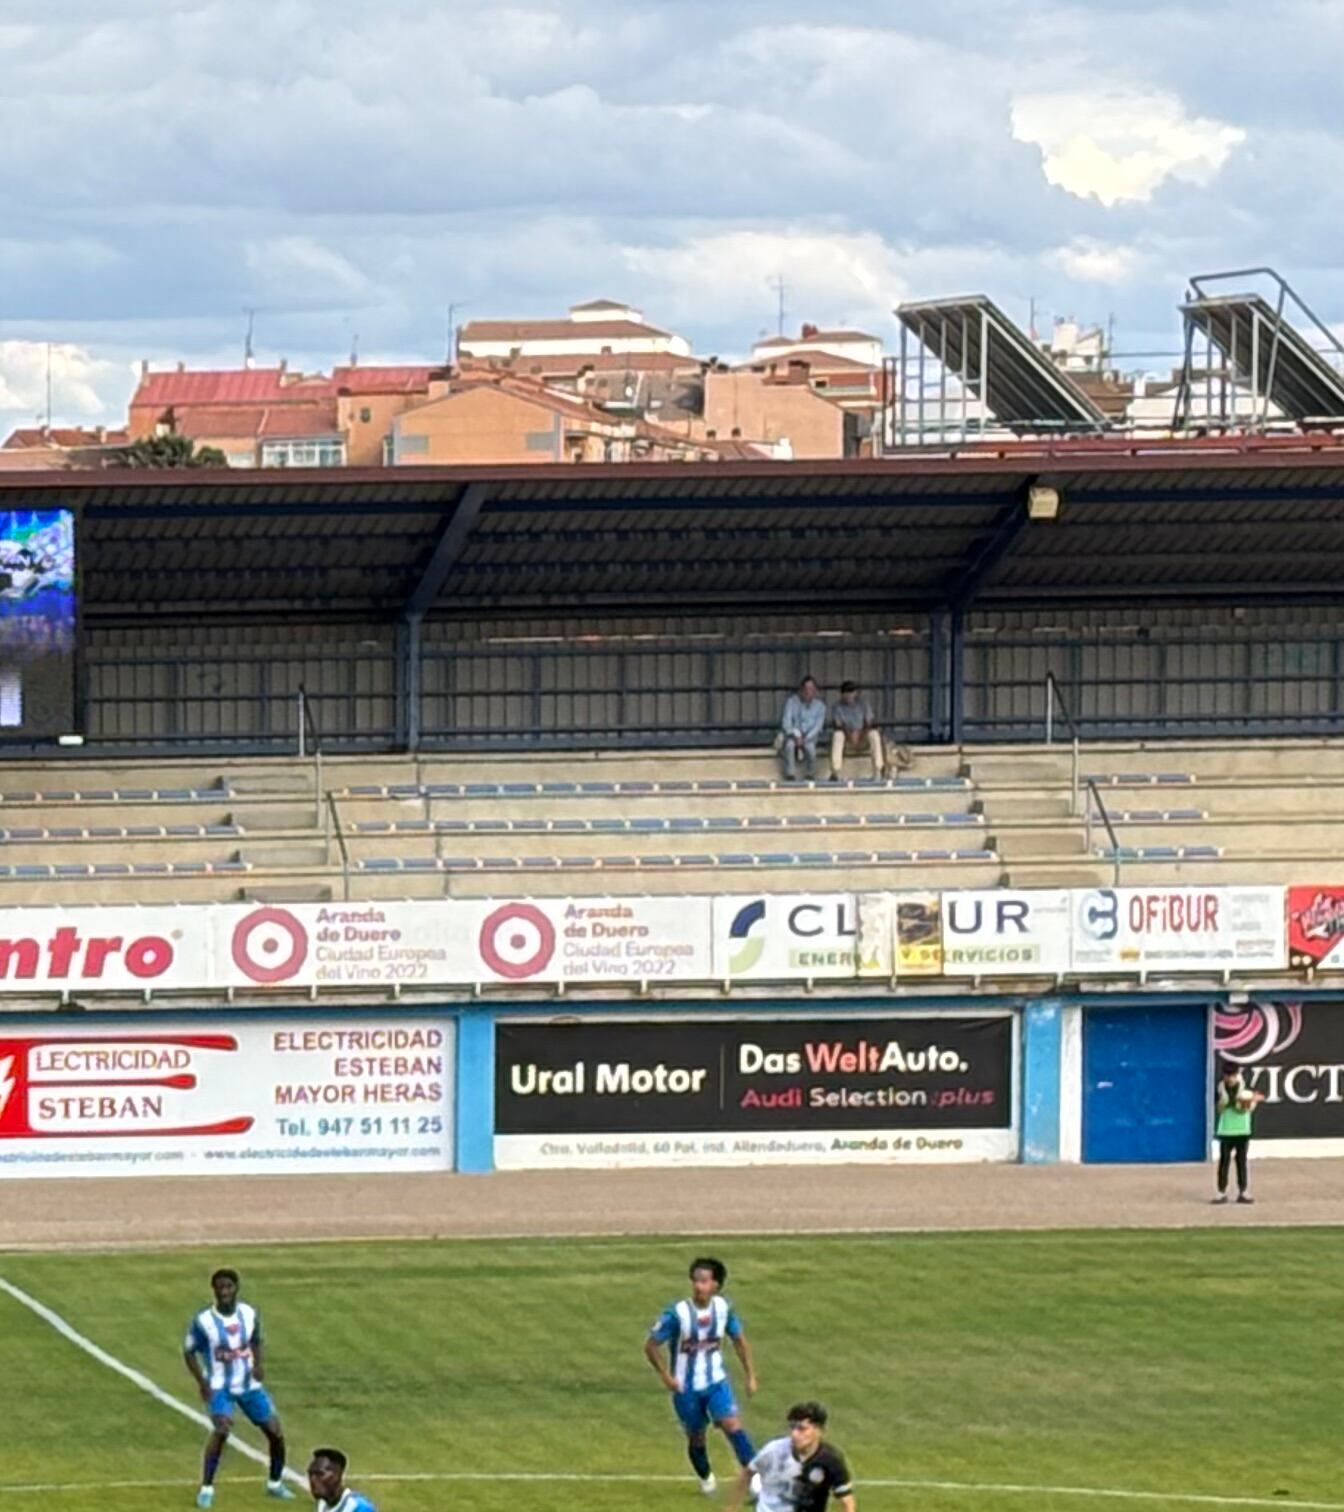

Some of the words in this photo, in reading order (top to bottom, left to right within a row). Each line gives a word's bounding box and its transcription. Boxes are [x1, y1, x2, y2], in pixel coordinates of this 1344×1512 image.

[316, 908, 386, 924] Aranda
[564, 904, 633, 919] Aranda
[316, 928, 340, 942] de
[345, 927, 401, 942] Duero
[564, 923, 588, 938] de
[592, 922, 649, 938] Duero
[315, 946, 374, 962] Ciudad
[379, 946, 447, 964] Europea
[563, 942, 622, 957] Ciudad
[626, 942, 694, 959] Europea
[316, 964, 342, 979] del
[346, 964, 380, 979] Vino
[384, 963, 428, 979] 2022
[563, 960, 589, 975] del
[593, 960, 627, 975] Vino
[632, 959, 676, 975] 2022
[273, 1030, 443, 1052] ELECTRICIDAD
[333, 1056, 443, 1078] ESTEBAN
[740, 1044, 802, 1074] Das
[511, 1062, 584, 1095] Ural
[596, 1062, 707, 1094] Motor
[274, 1083, 355, 1105] MAYOR
[363, 1082, 443, 1103] HERAS
[741, 1087, 802, 1108] Audi
[809, 1087, 928, 1108] Selection
[276, 1118, 311, 1136] Tel.
[318, 1118, 353, 1136] 947
[360, 1117, 385, 1135] 51
[391, 1116, 411, 1134] 11
[417, 1116, 443, 1134] 25
[830, 1137, 888, 1152] Aranda
[893, 1136, 912, 1151] de
[916, 1136, 964, 1151] Duero
